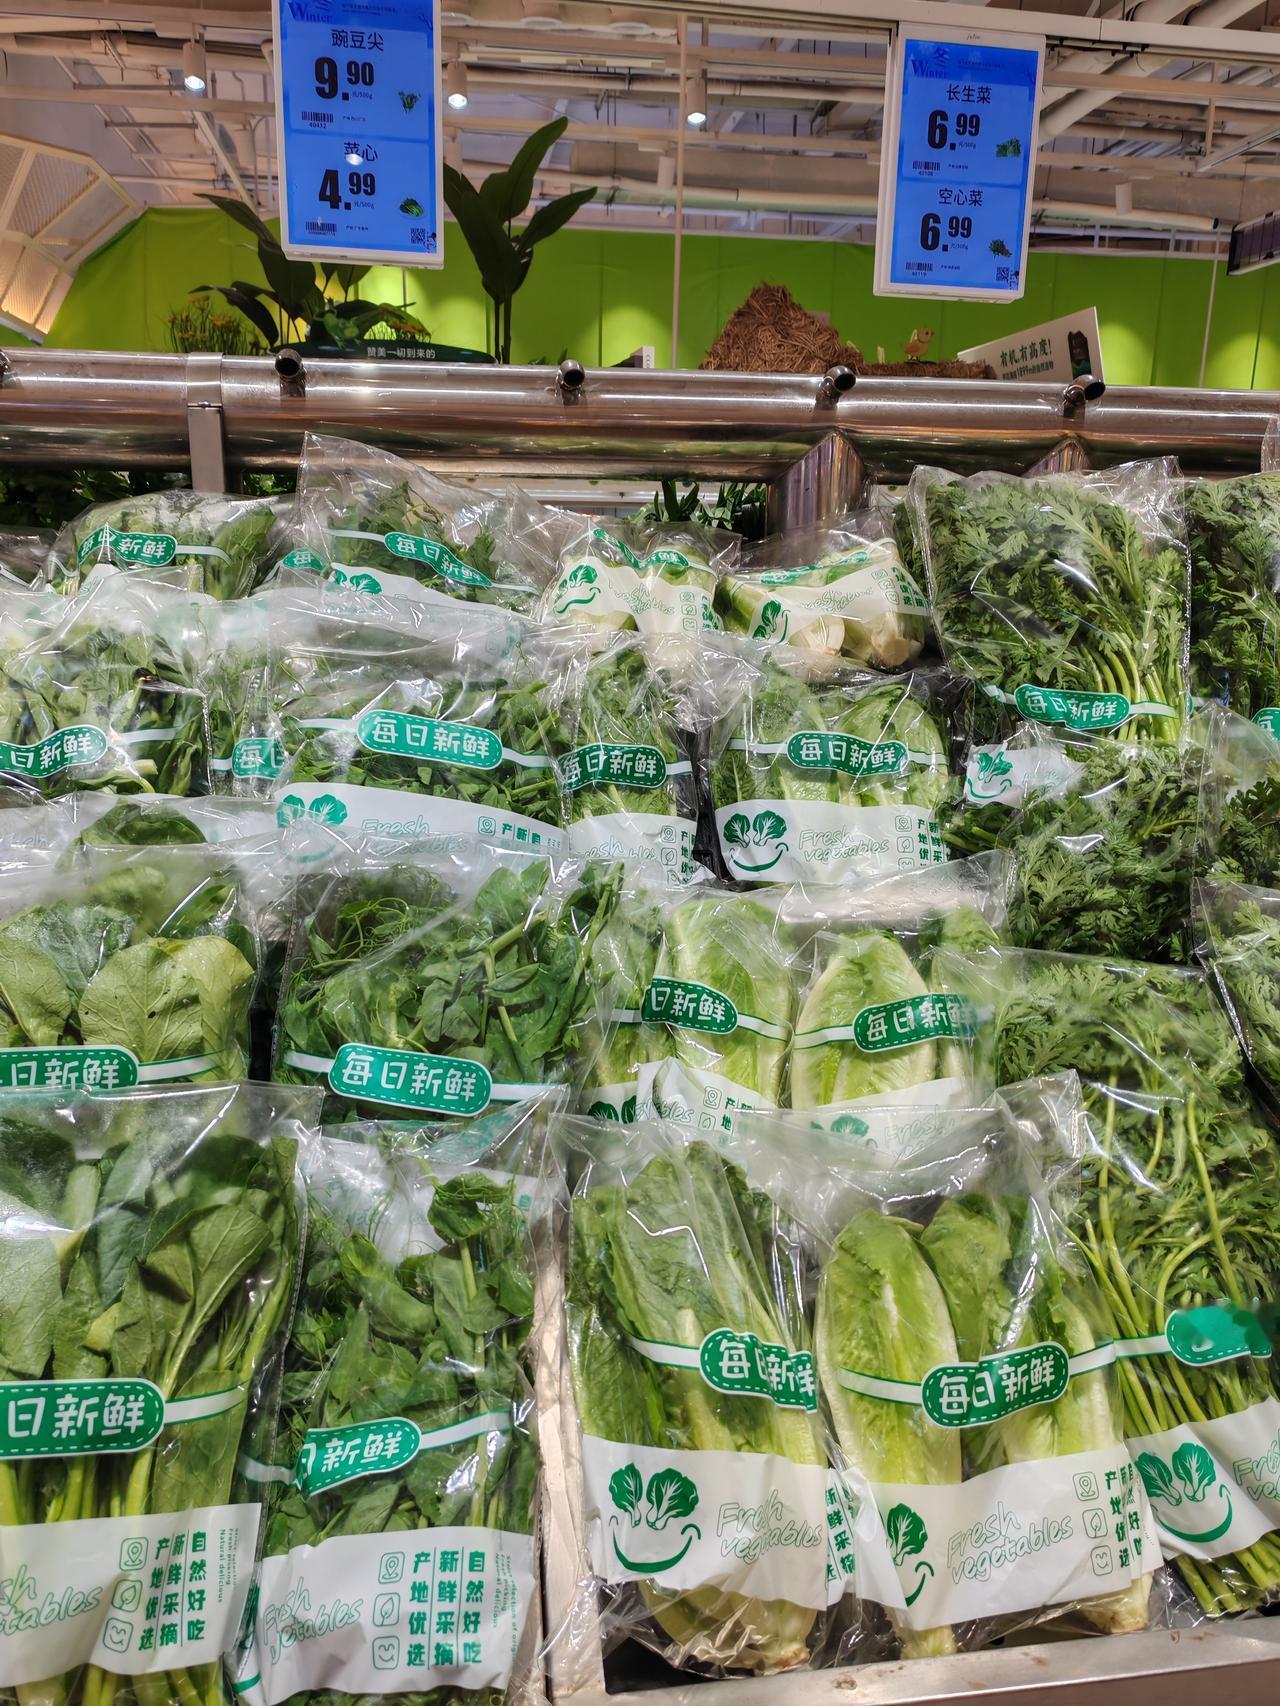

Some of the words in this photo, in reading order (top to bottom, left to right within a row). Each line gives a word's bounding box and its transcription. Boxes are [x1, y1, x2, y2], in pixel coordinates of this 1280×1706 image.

[288, 2, 332, 23] Winter
[331, 29, 384, 51] 豌豆尖
[911, 58, 948, 79] Winter
[946, 83, 992, 105] 长生菜
[343, 141, 379, 162] 菜心
[938, 188, 984, 207] 空心菜
[1024, 689, 1118, 721] 每日新鲜
[9, 731, 92, 769] 日新鲜
[372, 715, 490, 759] 每日新鲜
[799, 737, 896, 769] 每日新鲜
[563, 749, 657, 784] 每日新鲜
[799, 823, 854, 849] Fresh
[803, 839, 889, 863] vegetables
[651, 986, 726, 1024] 日新鲜
[10, 1057, 119, 1090] 日新鲜
[342, 1051, 476, 1102] 每日新鲜
[939, 1354, 1056, 1414] 每日新鲜
[8, 1392, 145, 1439] 日新鲜
[946, 1500, 1021, 1569] Fresh
[951, 1514, 1074, 1585] vegetables
[138, 1536, 170, 1652] 产地优选
[159, 1533, 186, 1647] 新鲜采摘
[187, 1531, 207, 1642] 自然好吃
[407, 1551, 431, 1667] 产地优选
[434, 1550, 459, 1666] 新鲜采摘
[462, 1551, 486, 1664] 自然好吃
